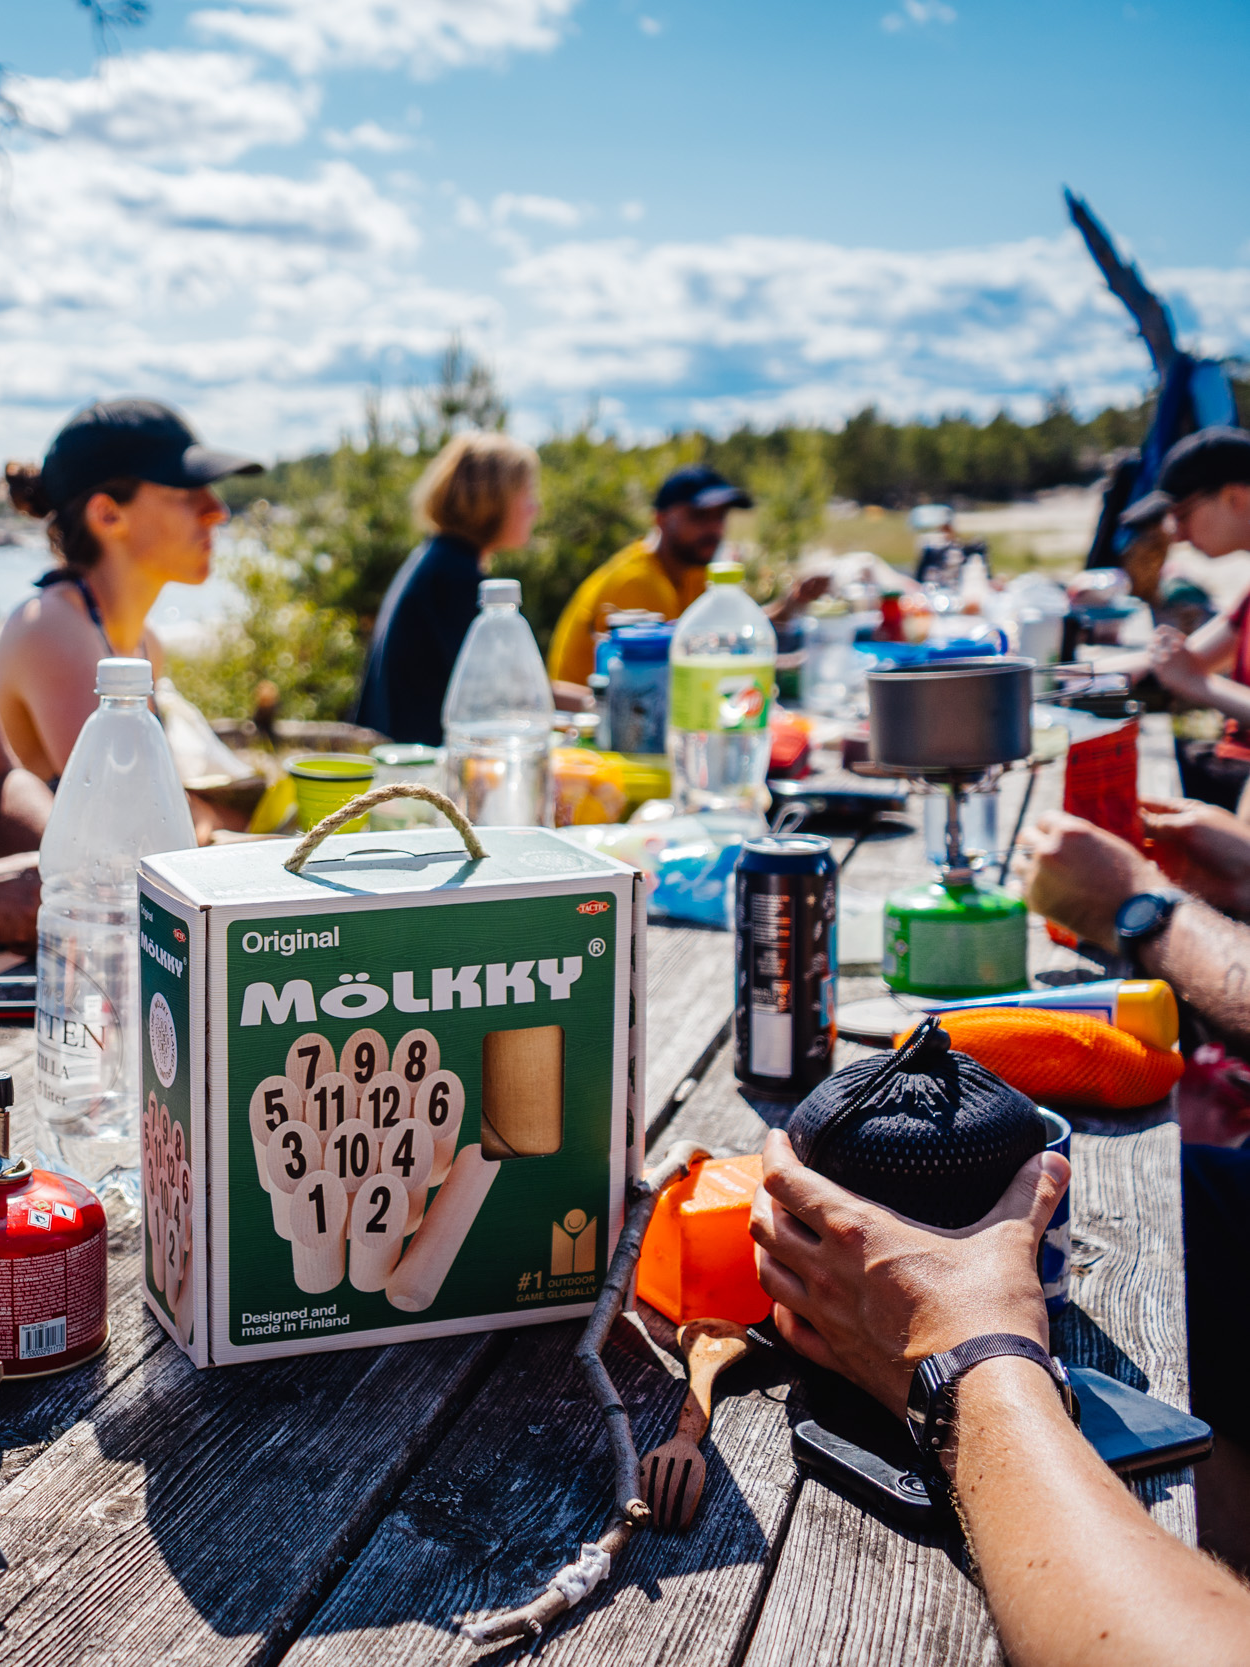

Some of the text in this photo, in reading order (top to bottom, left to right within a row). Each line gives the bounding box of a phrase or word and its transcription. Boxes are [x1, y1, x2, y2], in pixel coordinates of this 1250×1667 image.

[140, 931, 184, 979] MÖLKKY
[241, 926, 340, 956] Original
[297, 1040, 428, 1089] 7 9 8
[150, 1100, 182, 1162] 7 9 8
[263, 1081, 450, 1133] 5 11 12 6
[144, 1121, 189, 1205] 5 11 12 6
[282, 1129, 416, 1180] 3 10 4
[148, 1158, 181, 1232] 3 10 4
[308, 1184, 389, 1234] 1 2
[155, 1206, 175, 1268] 1 2
[516, 1286, 598, 1303] GAME GLOBALLY
[517, 1270, 596, 1292] #1 OUTDOOR
[241, 1304, 337, 1325] Designed and
[241, 1314, 350, 1337] made in Finland
[21, 1350, 25, 1358] 7
